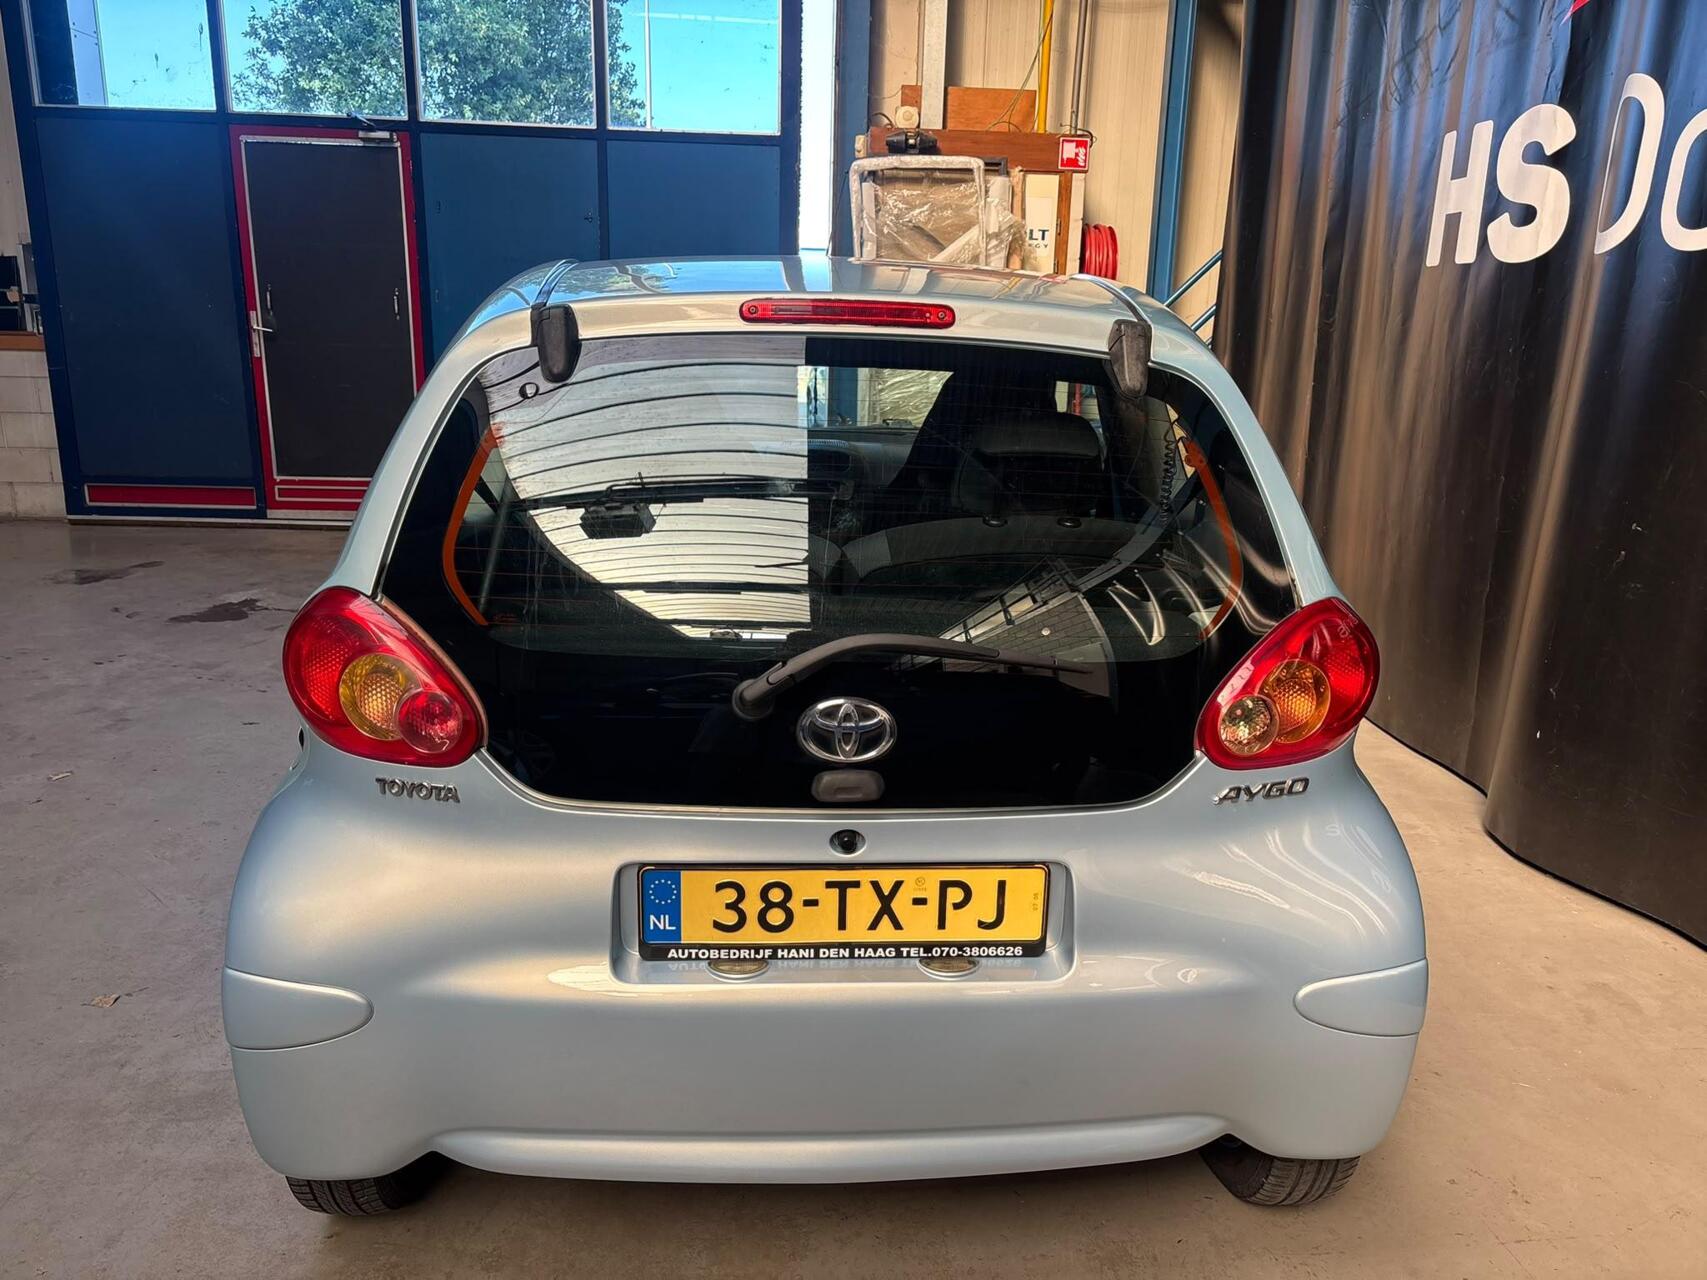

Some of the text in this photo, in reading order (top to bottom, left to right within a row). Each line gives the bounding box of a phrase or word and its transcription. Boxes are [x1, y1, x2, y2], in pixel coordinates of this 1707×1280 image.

[1426, 103, 1577, 267] HS
[375, 778, 460, 803] TOYOTA
[1212, 776, 1310, 805] AYGO
[712, 879, 1008, 934] 38-TX-PJ
[649, 914, 677, 930] NL
[667, 946, 1024, 960] AUTOBEDRIJF HANI DEN HAAG TEL.070-3806626
